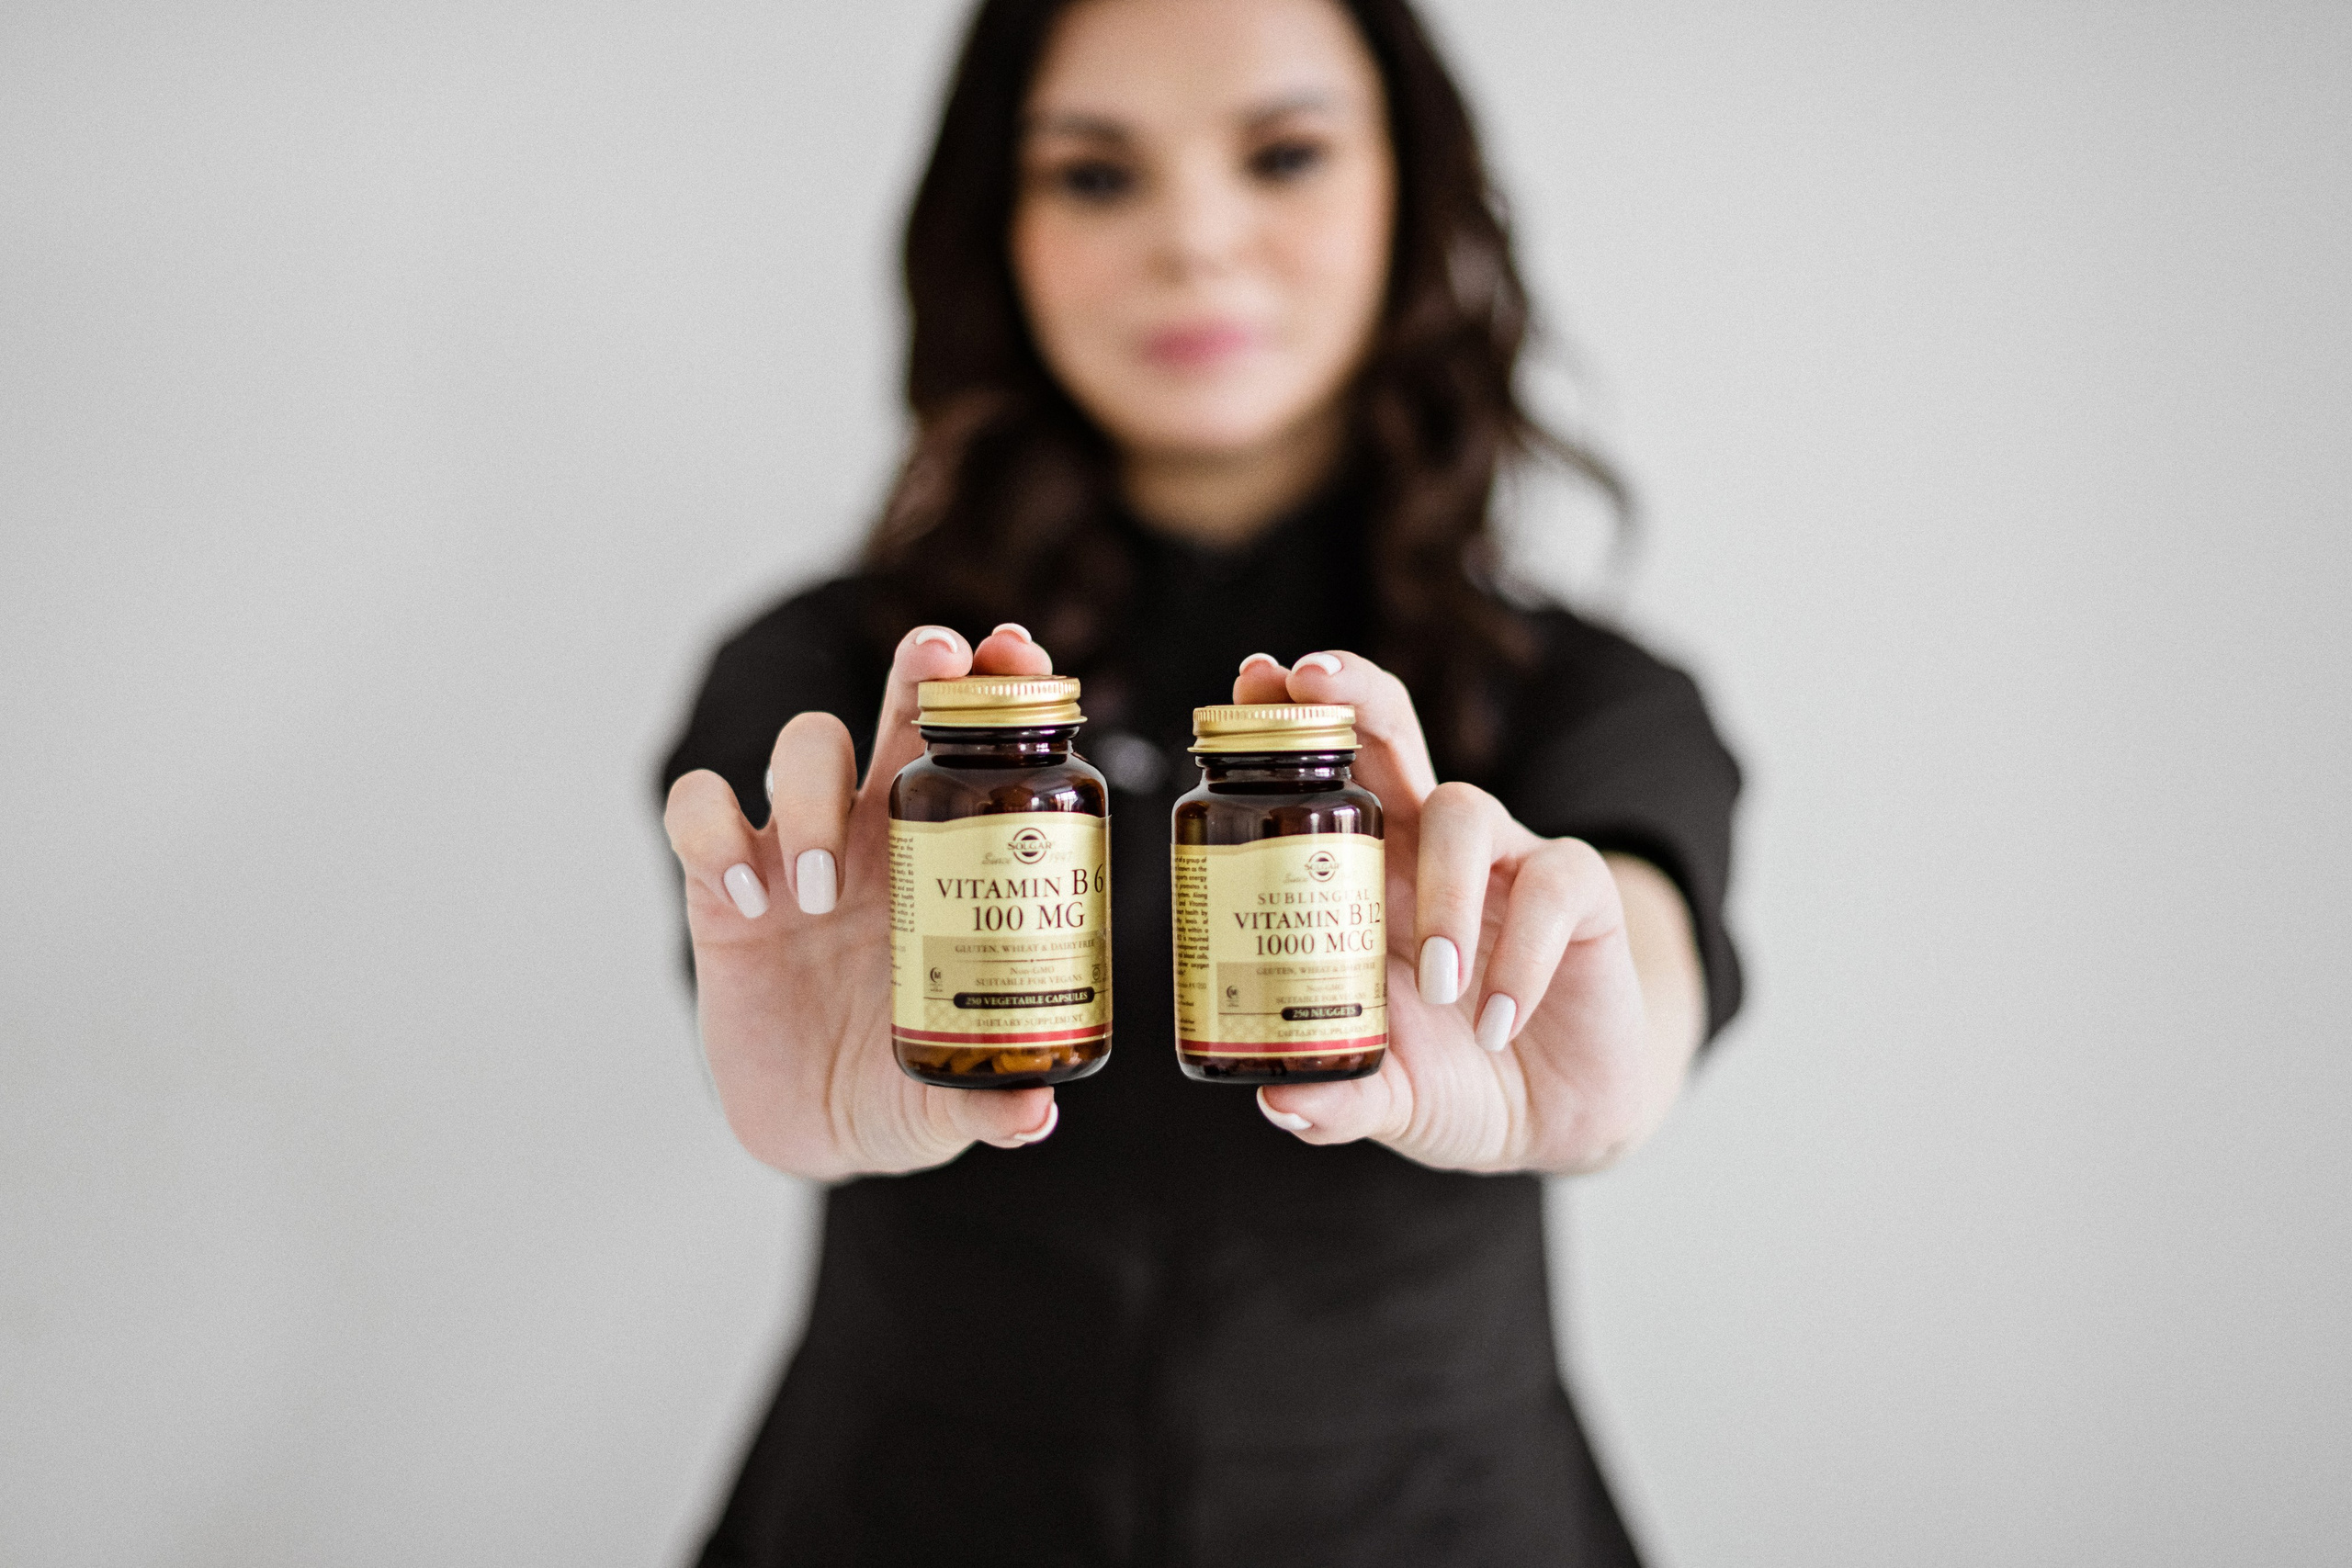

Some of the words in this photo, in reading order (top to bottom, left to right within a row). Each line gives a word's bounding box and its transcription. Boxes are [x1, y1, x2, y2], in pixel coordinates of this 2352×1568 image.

[1008, 841, 1052, 851] SOLGAR
[936, 876, 1061, 899] VITAMIN
[1071, 868, 1089, 896] B
[1093, 863, 1103, 894] 6
[972, 905, 1023, 931] 100
[1036, 901, 1086, 930] MG
[1233, 908, 1340, 930] VITAMIN
[1349, 903, 1363, 926] B
[1369, 901, 1381, 924] 12
[1001, 943, 1039, 953] WHEAT
[1050, 940, 1076, 951] DAIRY
[1255, 932, 1315, 955] 1000
[1326, 929, 1374, 953] MCG
[976, 976, 1026, 987] SUITABLE
[1027, 976, 1046, 986] FOR
[1047, 974, 1082, 985] VEGANS
[966, 997, 982, 1006] 250
[983, 995, 1043, 1006] VEGETABLE
[1045, 991, 1088, 1004] CAPSULES
[1293, 1010, 1309, 1019] 250
[1310, 1006, 1356, 1018] NUGGETS
